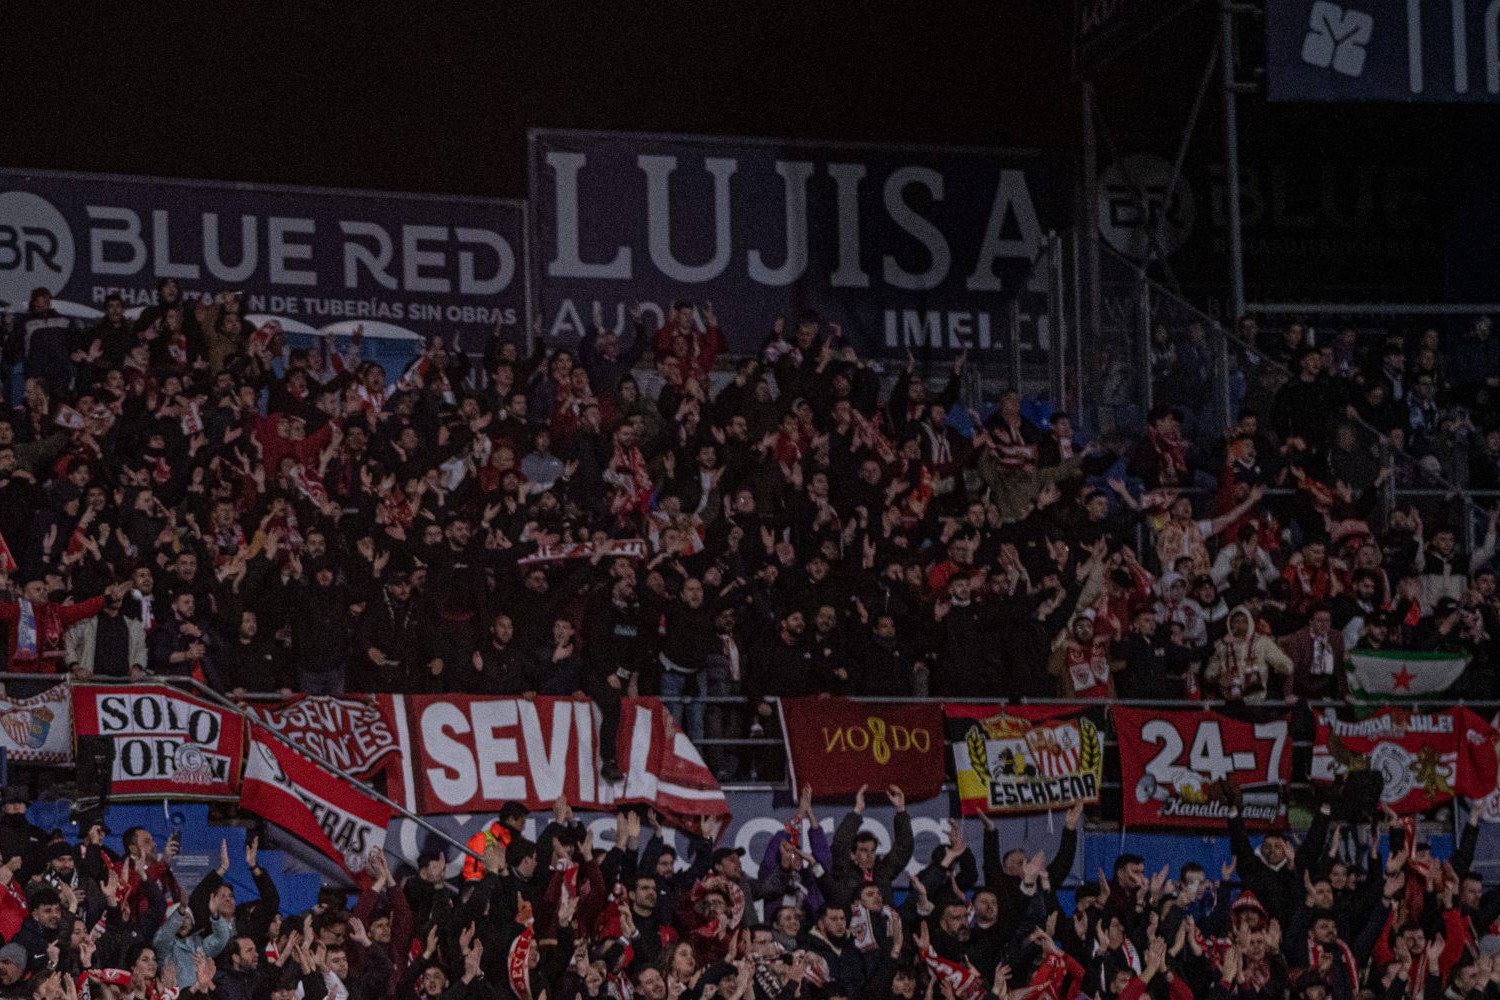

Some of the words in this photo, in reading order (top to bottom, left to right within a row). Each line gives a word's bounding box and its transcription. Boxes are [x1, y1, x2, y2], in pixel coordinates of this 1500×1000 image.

[86, 204, 318, 286] BLUE
[339, 220, 515, 295] RED
[546, 151, 1050, 292] LUJISA
[303, 295, 402, 319] TUBERÍAS
[408, 302, 443, 320] SIN
[447, 304, 517, 325] OBRAS
[100, 694, 220, 746] SOLO
[120, 738, 182, 776] OR
[1141, 719, 1288, 784] 24-7
